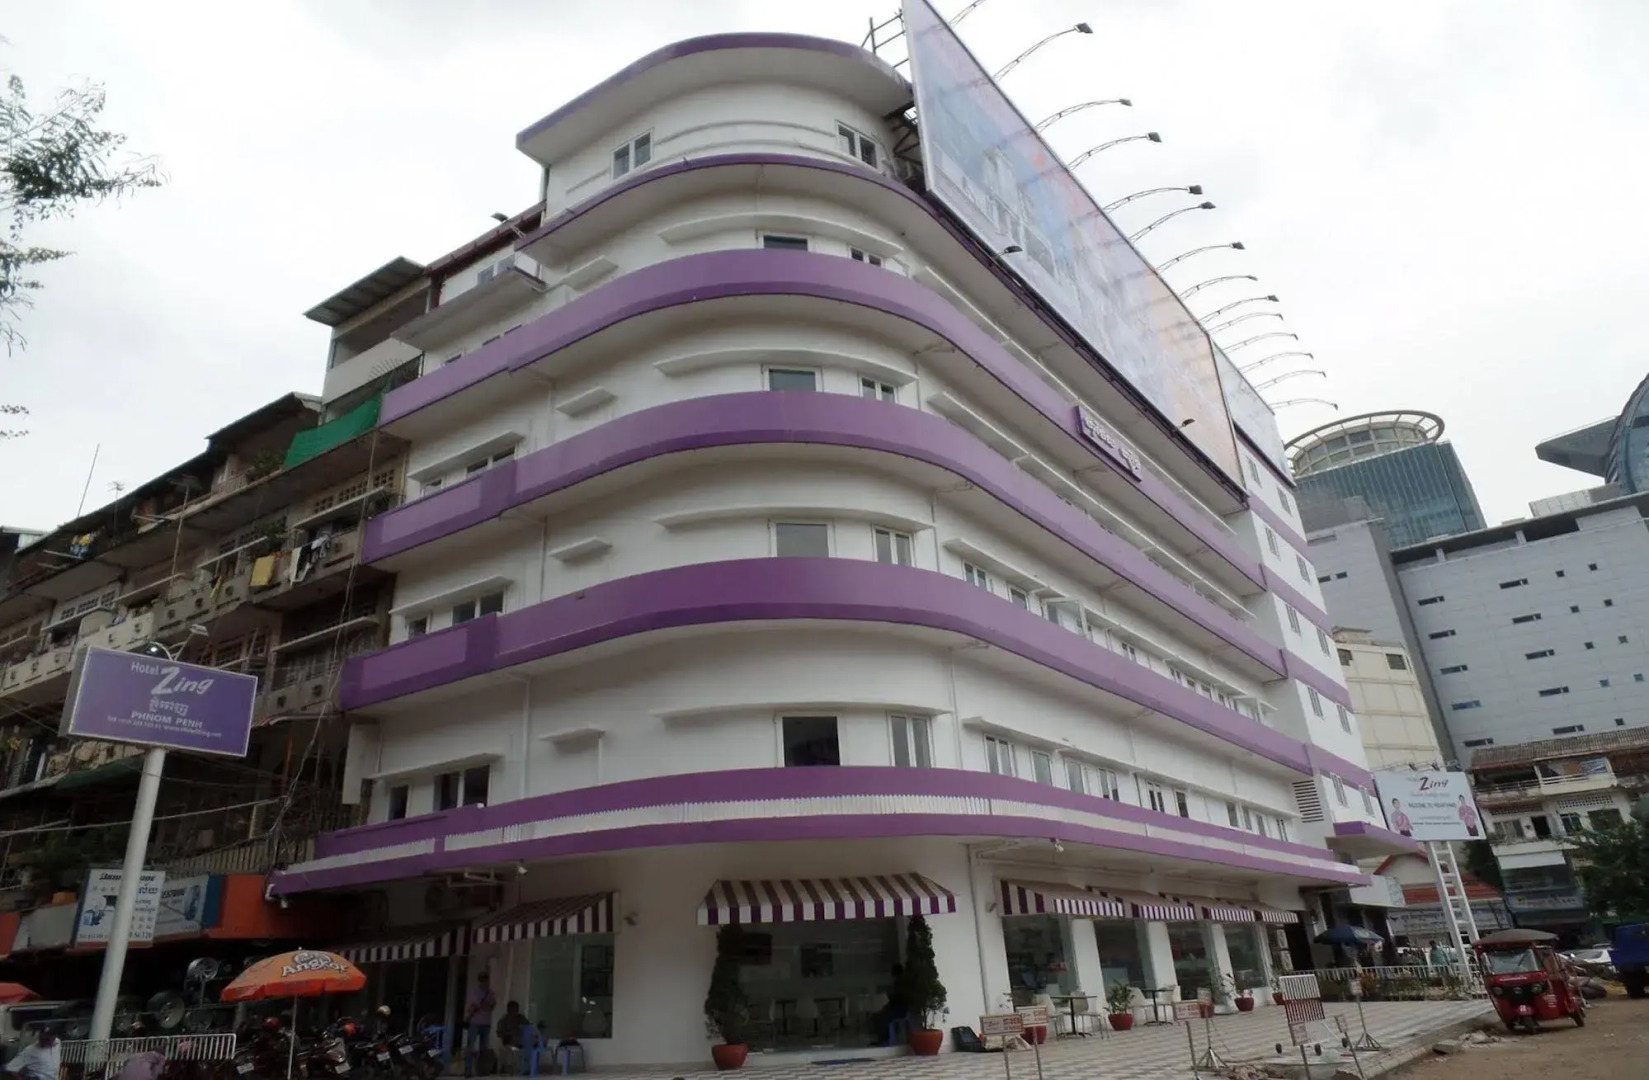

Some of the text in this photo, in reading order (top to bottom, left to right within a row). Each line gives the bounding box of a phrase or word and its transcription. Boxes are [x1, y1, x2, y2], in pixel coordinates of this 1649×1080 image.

[131, 661, 215, 695] Hotel Zing
[131, 711, 172, 724] PHNOM
[175, 717, 203, 729] PENH
[1419, 776, 1449, 791] Zing
[281, 957, 349, 977] Angkor
